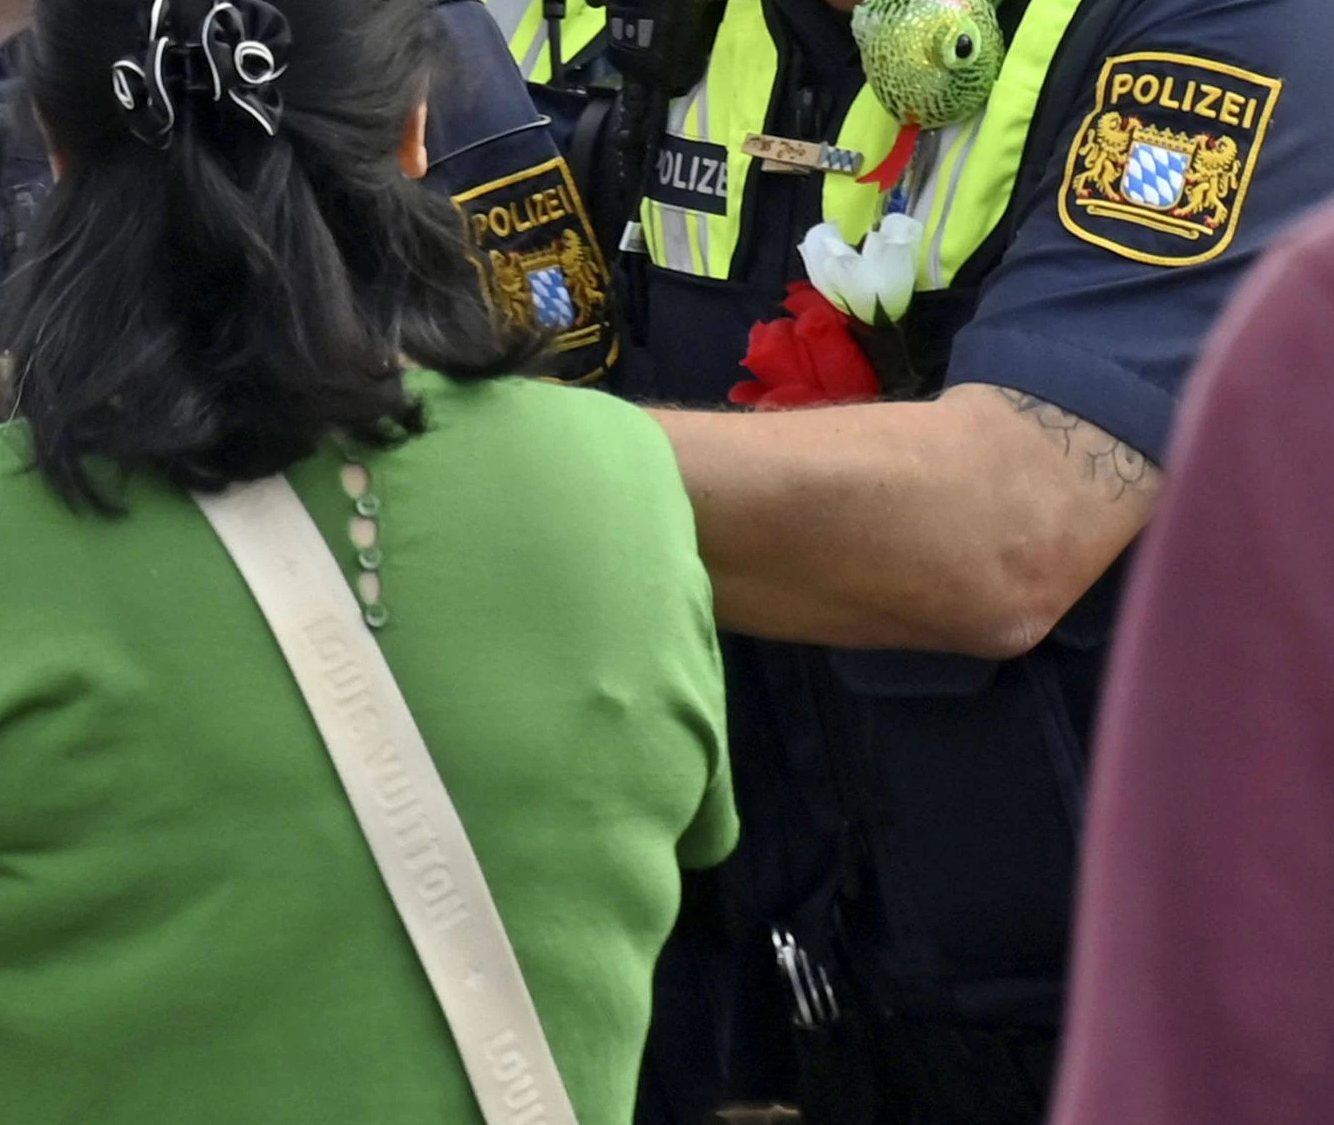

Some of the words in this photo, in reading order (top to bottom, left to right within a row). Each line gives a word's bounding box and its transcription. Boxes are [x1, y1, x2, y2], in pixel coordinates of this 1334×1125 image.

[1110, 73, 1259, 129] POLIZEI
[471, 185, 574, 247] POLIZEI
[364, 740, 470, 933] VUITTON
[485, 1026, 549, 1125] LOUI
